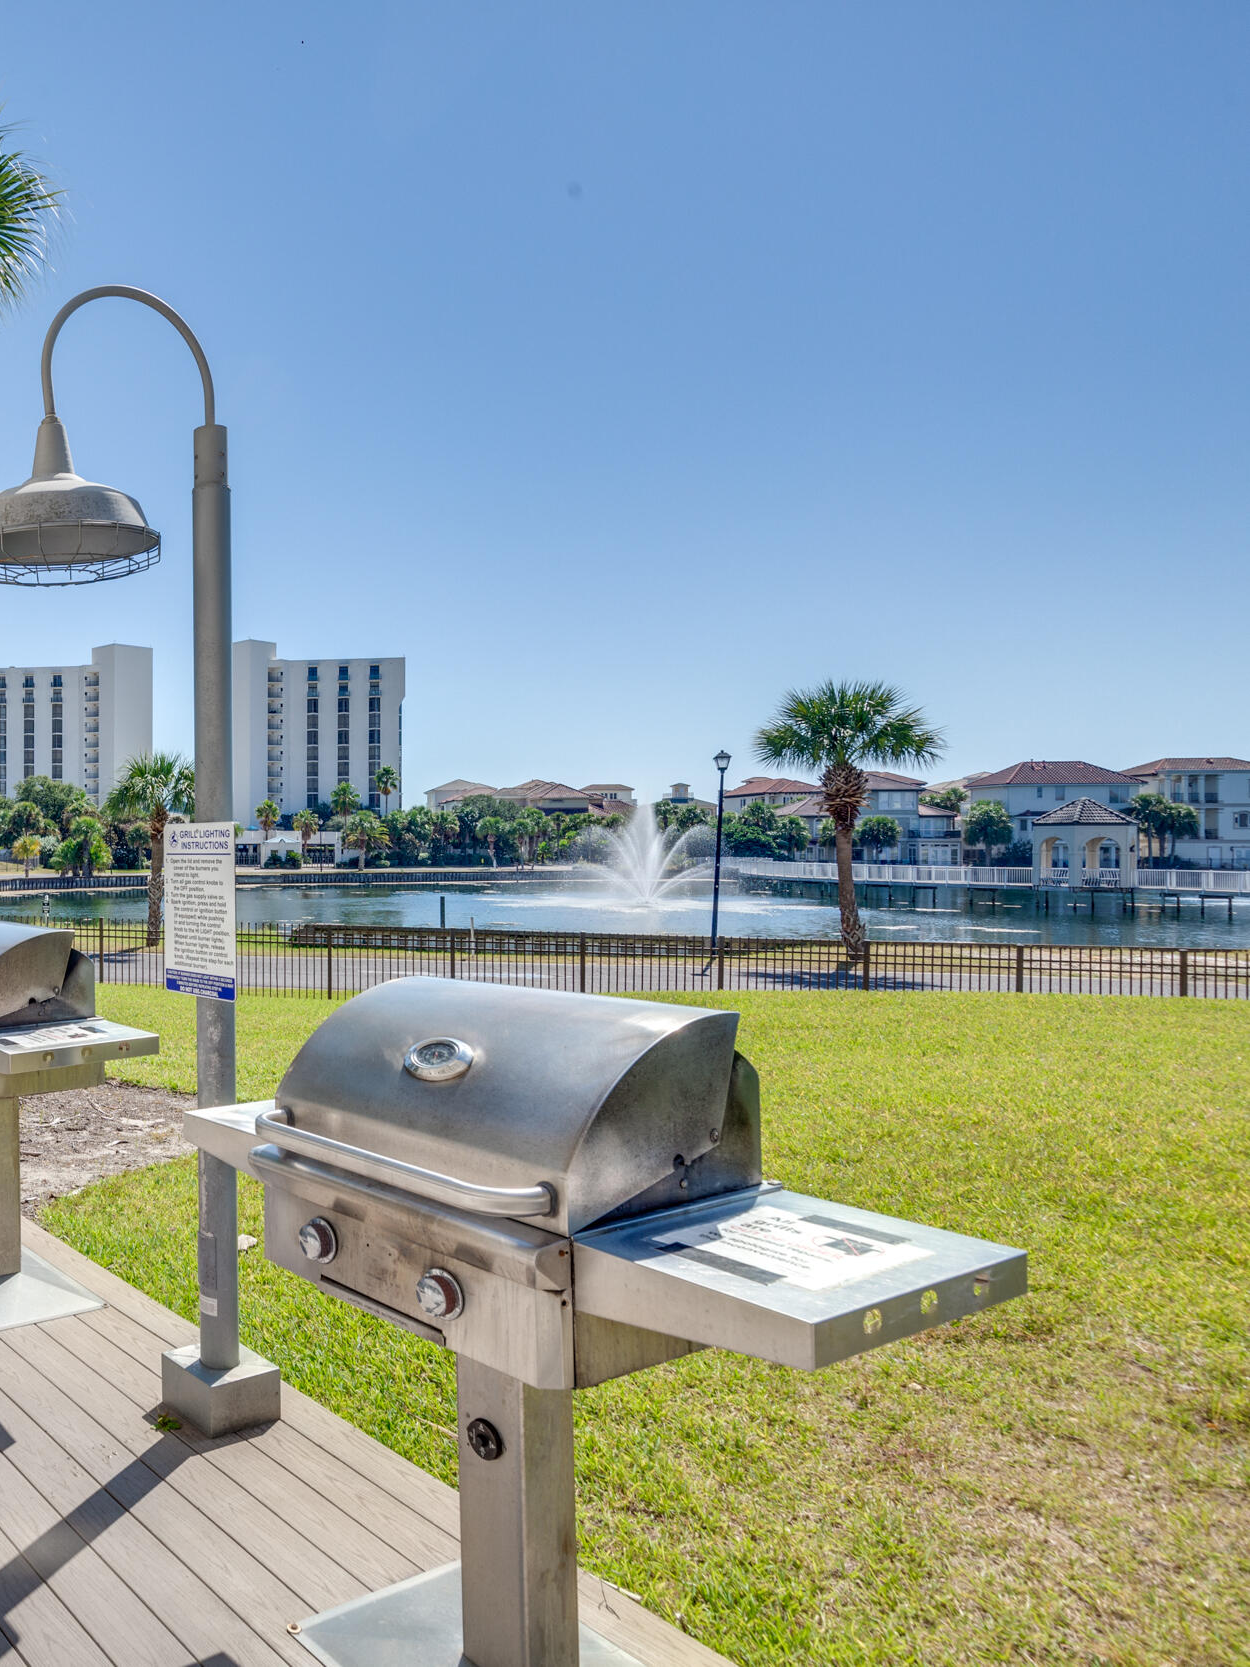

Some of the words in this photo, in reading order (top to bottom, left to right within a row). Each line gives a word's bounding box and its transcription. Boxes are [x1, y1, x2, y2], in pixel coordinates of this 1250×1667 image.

[180, 830, 197, 839] GRILL
[199, 829, 230, 838] LIGHTING
[181, 841, 229, 849] INSTRUCTIONS
[740, 1223, 772, 1233] are
[752, 1220, 802, 1234] grills
